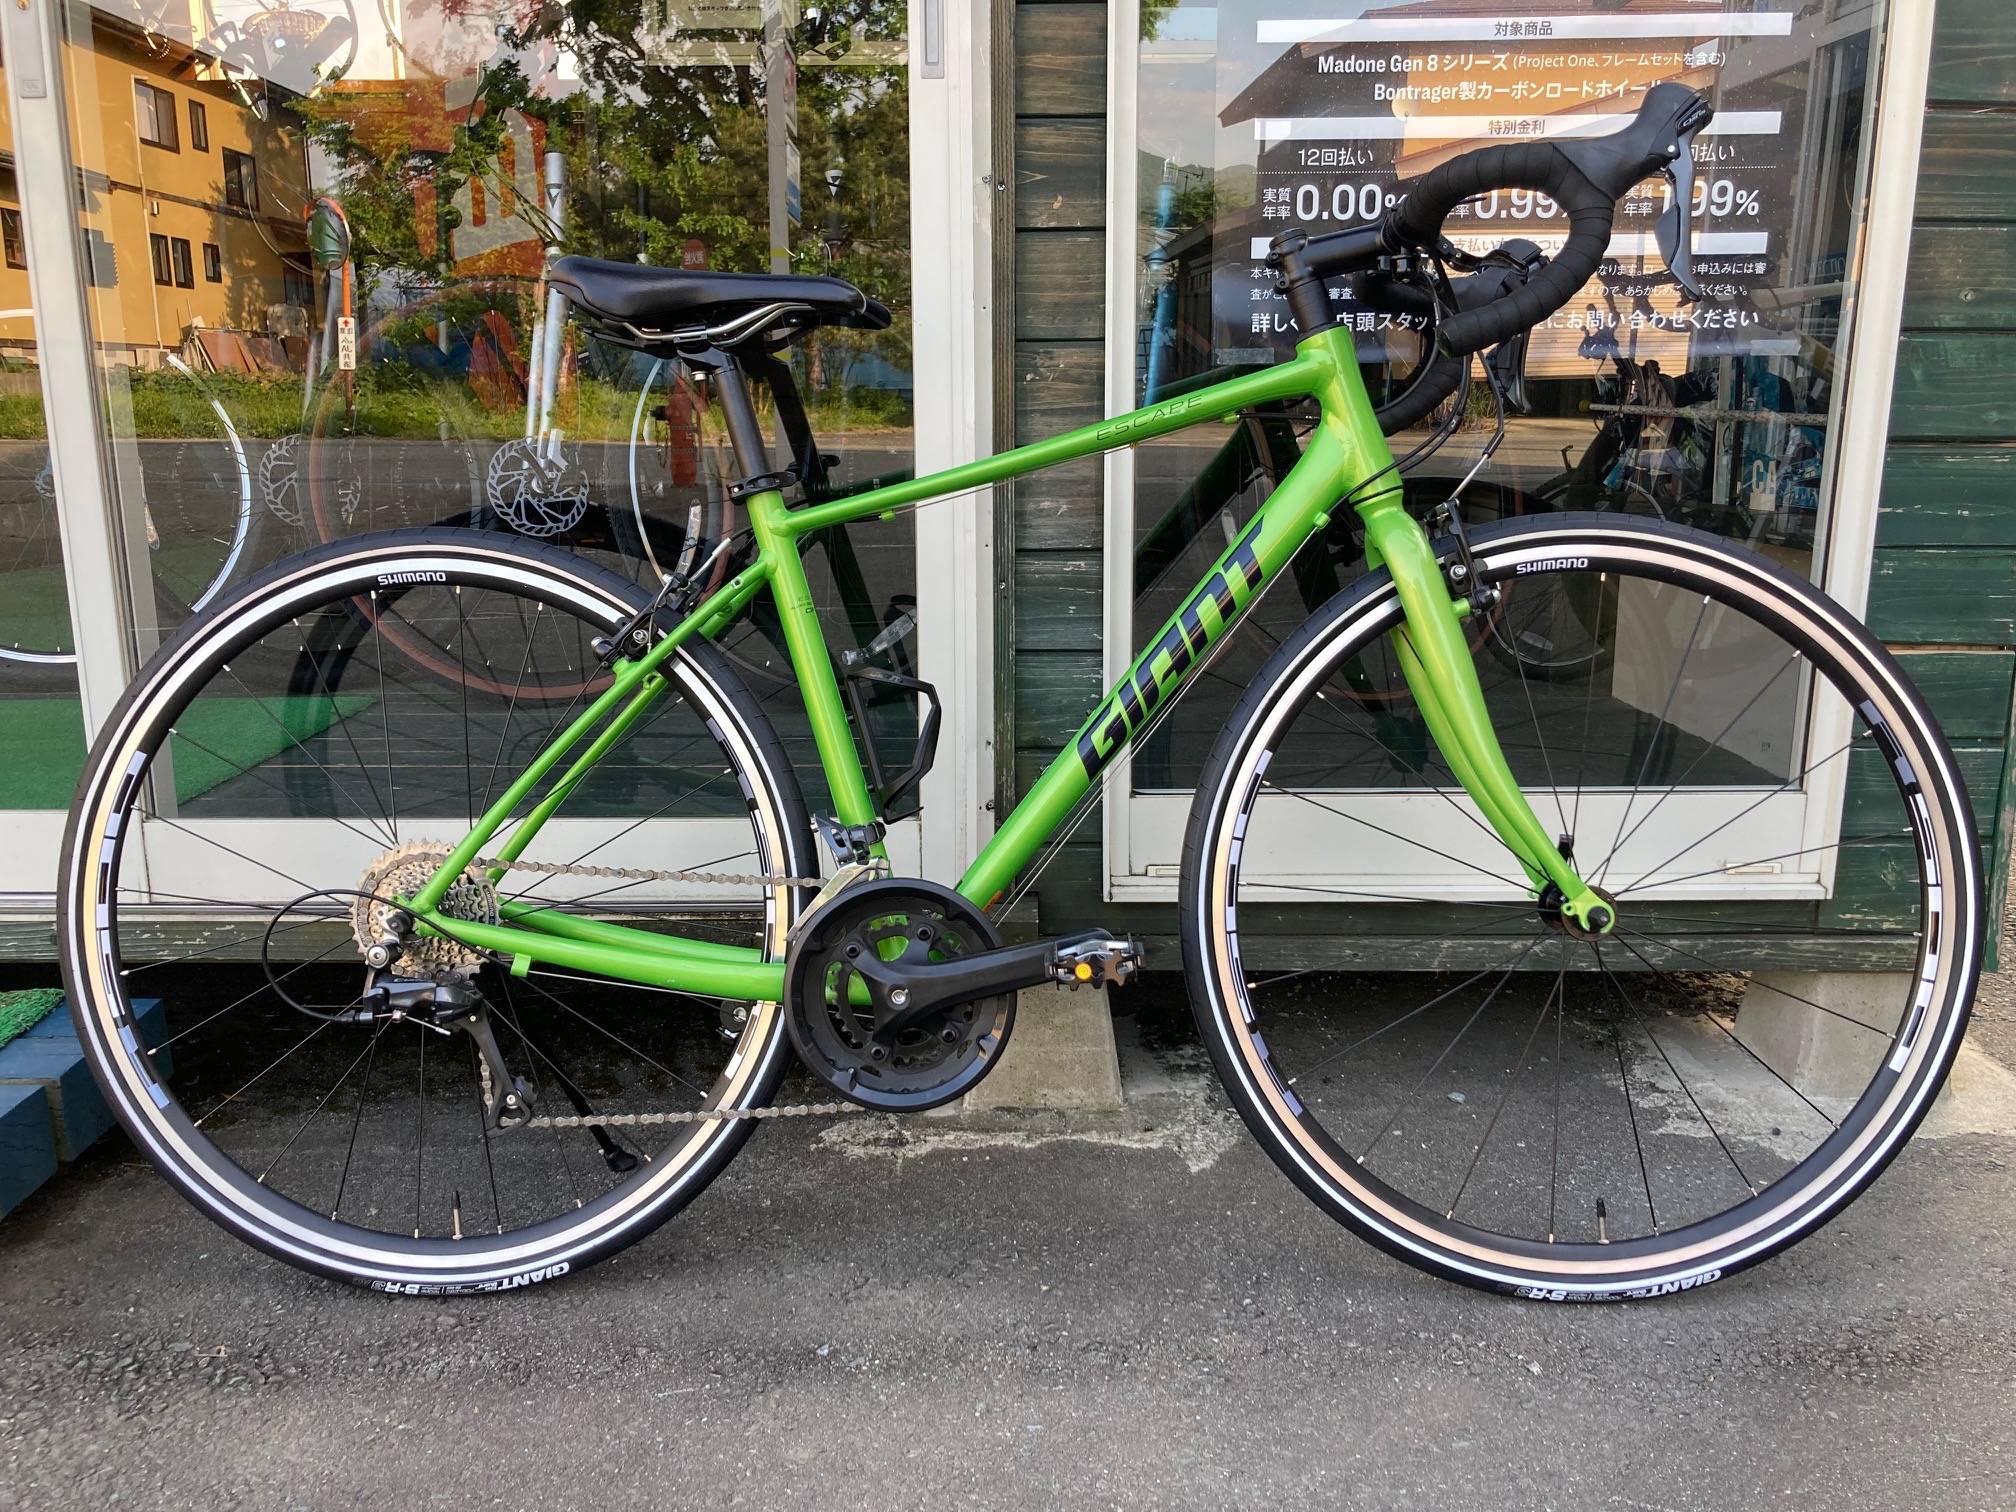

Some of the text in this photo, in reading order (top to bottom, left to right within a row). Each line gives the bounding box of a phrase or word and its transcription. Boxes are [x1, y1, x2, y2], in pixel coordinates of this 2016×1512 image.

[1494, 21, 1553, 36] 対象商品
[1317, 55, 1386, 73] Madone
[1389, 55, 1423, 72] Gen
[1513, 55, 1565, 69] (Project
[1488, 119, 1545, 135] 特別金利
[1298, 148, 1374, 166] 12回払い
[1263, 187, 1291, 203] 実質
[1625, 184, 1654, 199] 実質
[1262, 205, 1291, 220] 年率
[1623, 202, 1652, 217] 年率
[1096, 394, 1203, 441] ESCAPE
[1516, 557, 1589, 575] SHIMANO
[377, 571, 447, 586] SHIMANO
[1076, 513, 1266, 781] GIANT
[497, 1261, 570, 1290] GIANT
[1645, 1269, 1722, 1298] GIANT
